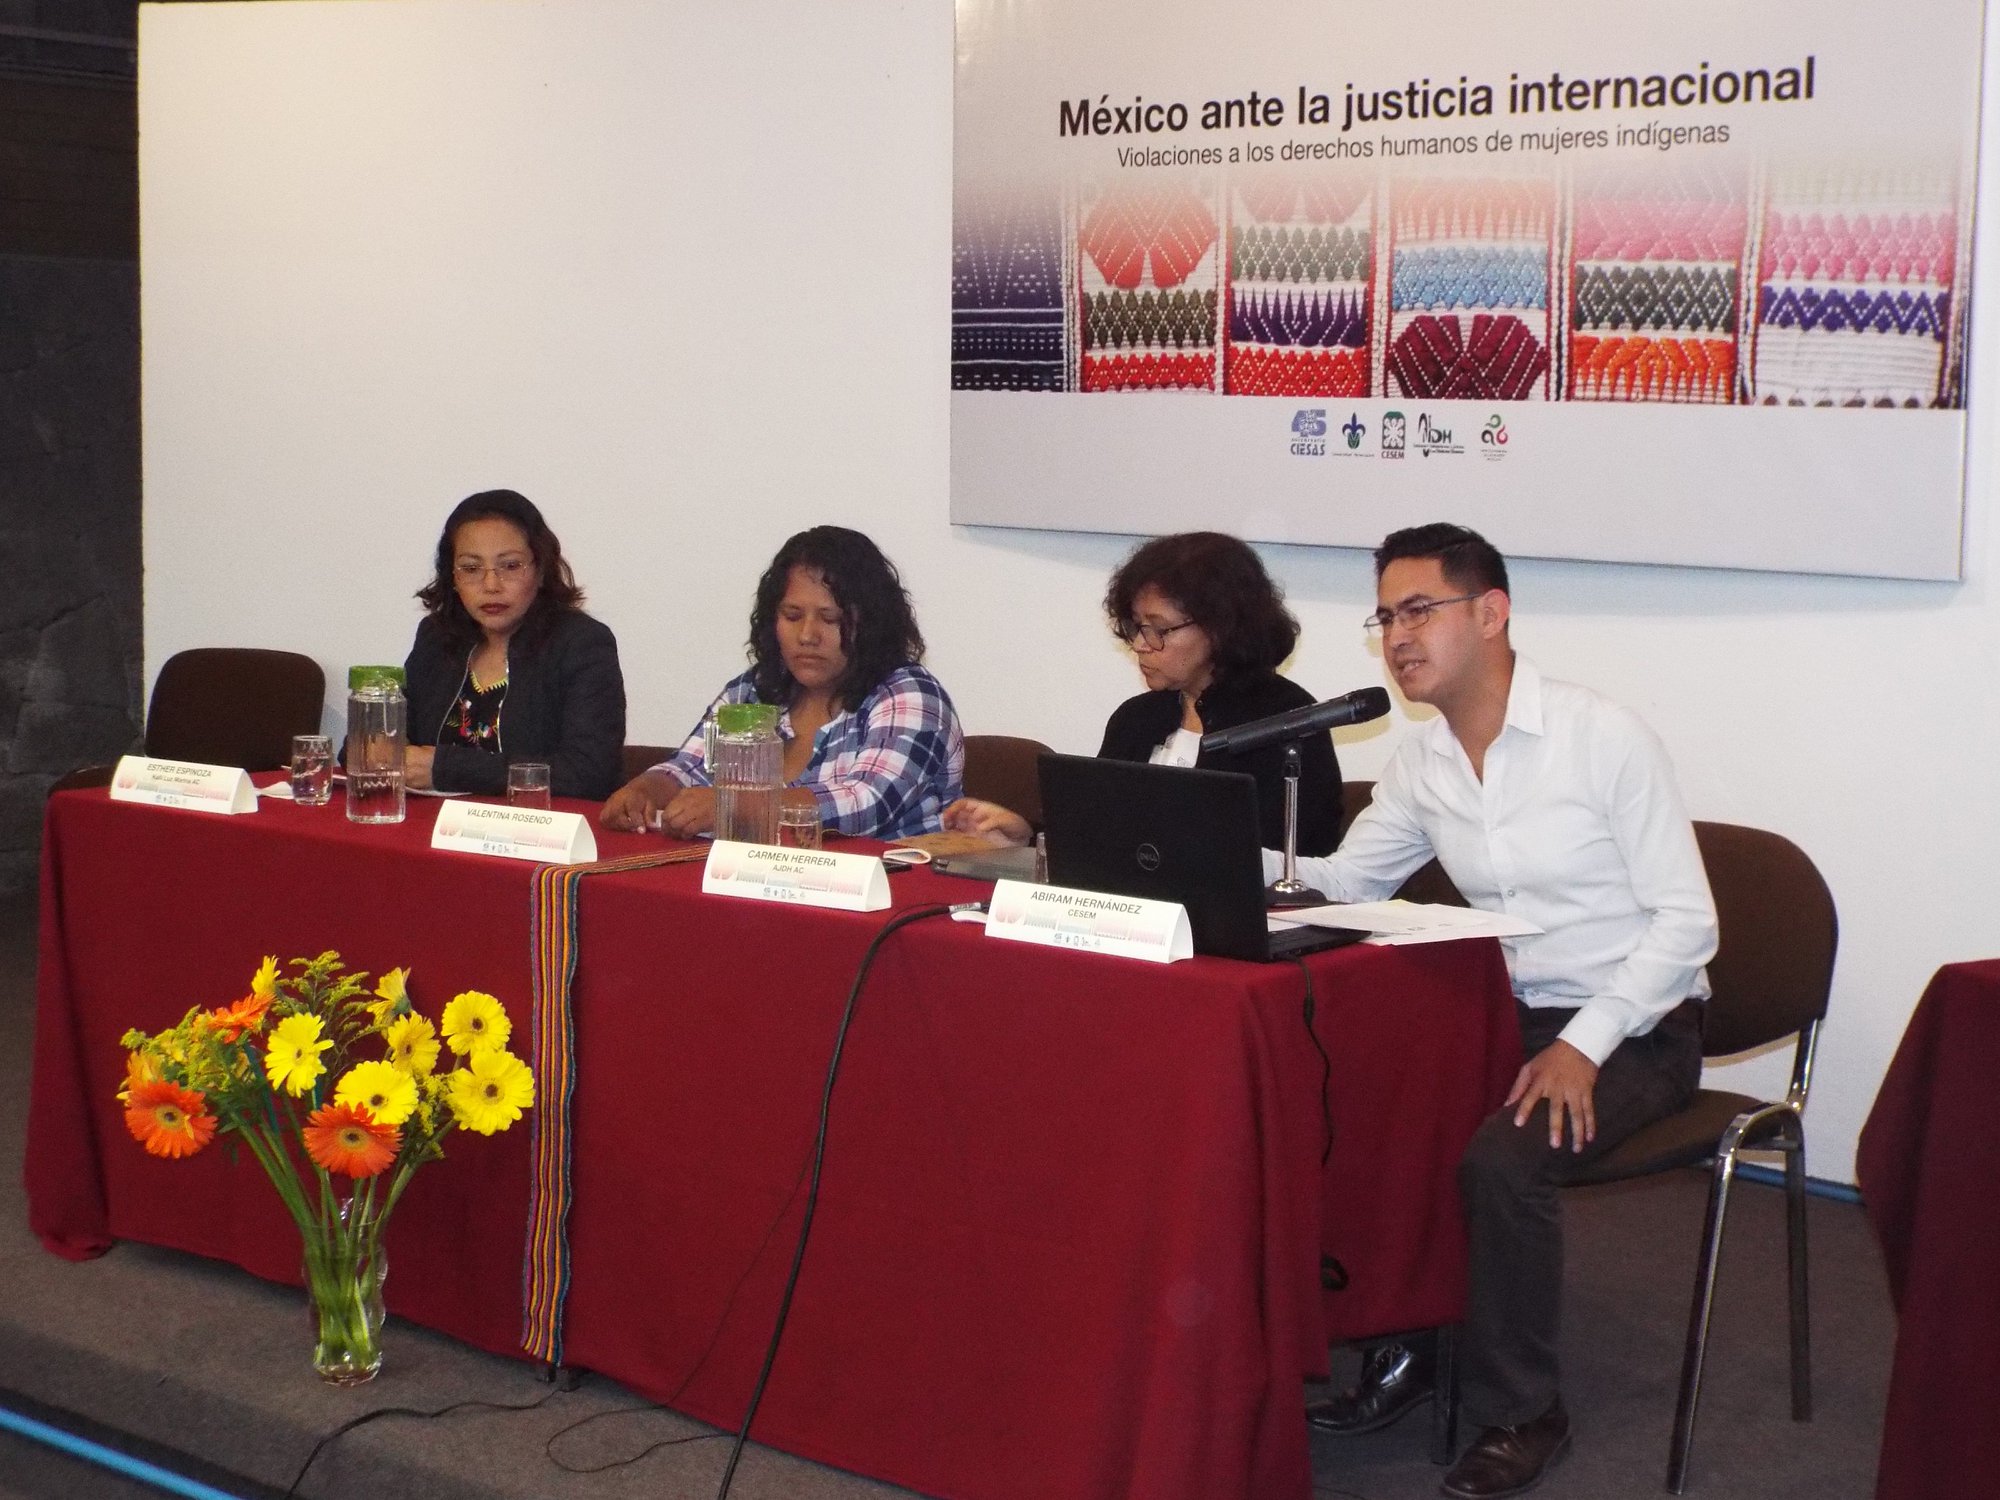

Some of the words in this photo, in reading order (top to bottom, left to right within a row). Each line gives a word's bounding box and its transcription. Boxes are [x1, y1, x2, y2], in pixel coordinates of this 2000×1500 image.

[1059, 94, 1189, 137] México
[1200, 91, 1285, 130] ante
[1298, 86, 1330, 125] la
[1341, 76, 1493, 132] justicia
[1509, 55, 1816, 114] internacional
[1117, 145, 1223, 168] Violaciones
[1228, 146, 1241, 163] a
[1246, 141, 1275, 162] los
[1280, 139, 1374, 161] derechos
[1380, 134, 1479, 157] humanos
[1484, 129, 1513, 153] de
[1520, 126, 1609, 155] mujeres
[1616, 120, 1731, 151] indígenas
[1290, 443, 1326, 457] CIESAS
[1381, 450, 1405, 460] CESEM
[147, 763, 176, 774] ESTHER
[176, 766, 212, 778] ESPINOZA
[467, 808, 510, 821] VALENTINA
[512, 813, 553, 825] ROSENDO
[747, 849, 789, 863] CARMEN
[790, 855, 837, 868] HERRERA
[792, 866, 804, 875] AC
[1031, 890, 1073, 905] ABIRAM
[1074, 898, 1143, 915] HERNÁNDEZ
[1067, 908, 1097, 920] CESEM
